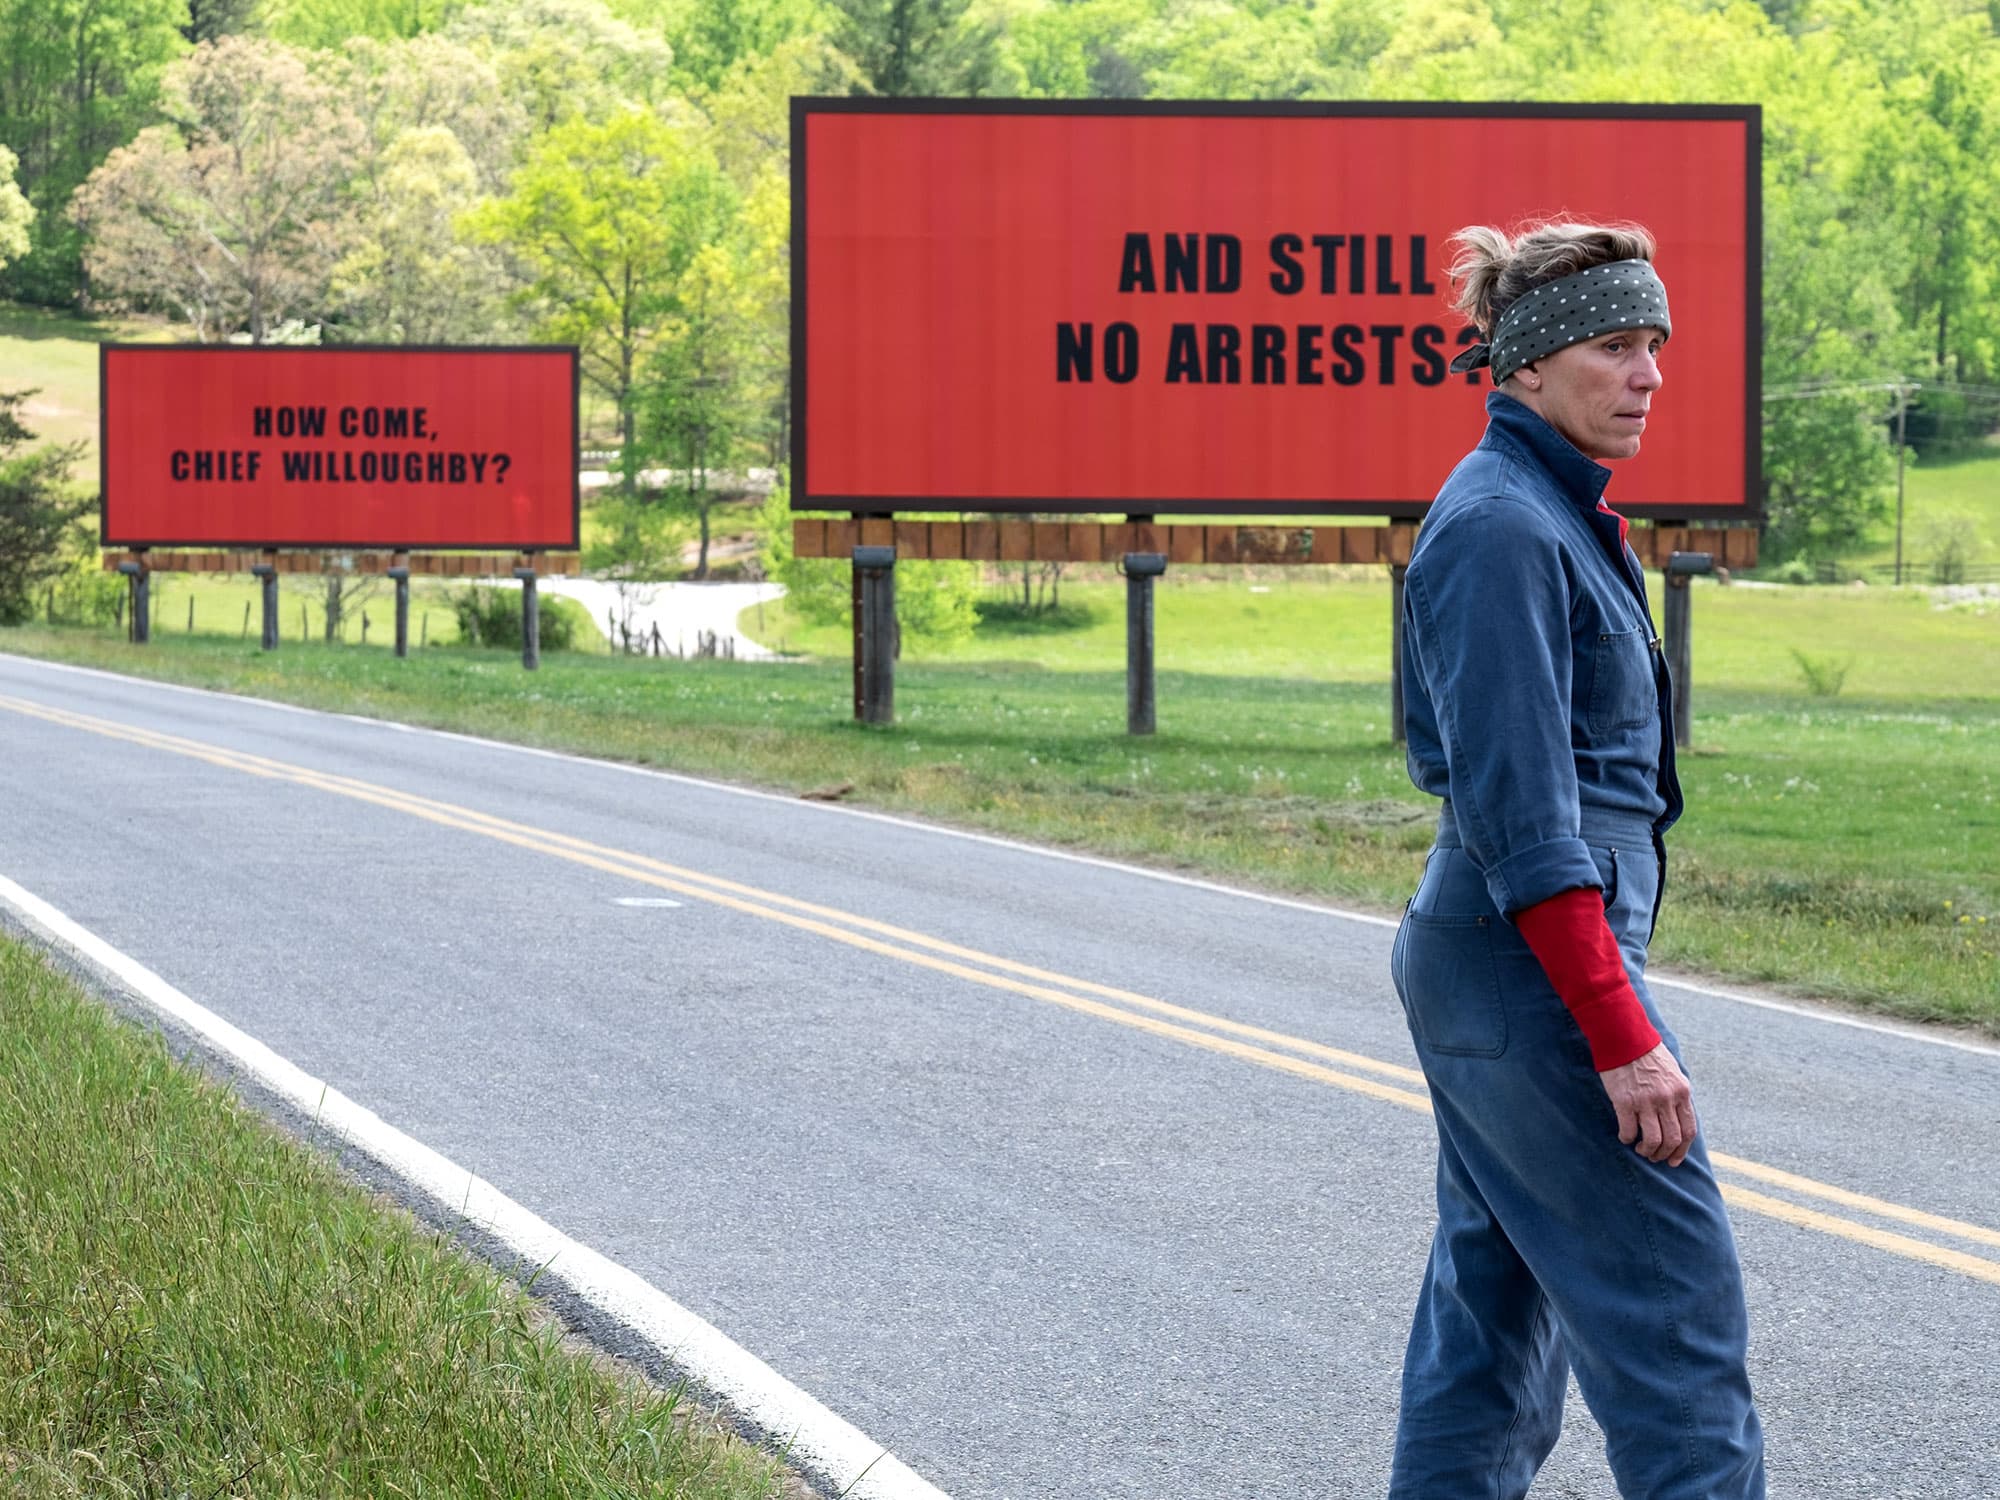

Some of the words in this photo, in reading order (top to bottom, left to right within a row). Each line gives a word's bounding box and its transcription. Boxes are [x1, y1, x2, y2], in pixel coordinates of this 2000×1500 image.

[1118, 232, 1242, 294] AND
[1268, 233, 1436, 296] STILL
[1055, 321, 1140, 385] NO
[253, 405, 328, 438] HOW
[338, 406, 438, 441] COME,
[170, 450, 262, 482] CHIEF
[282, 451, 512, 484] WILLOUGHBY?
